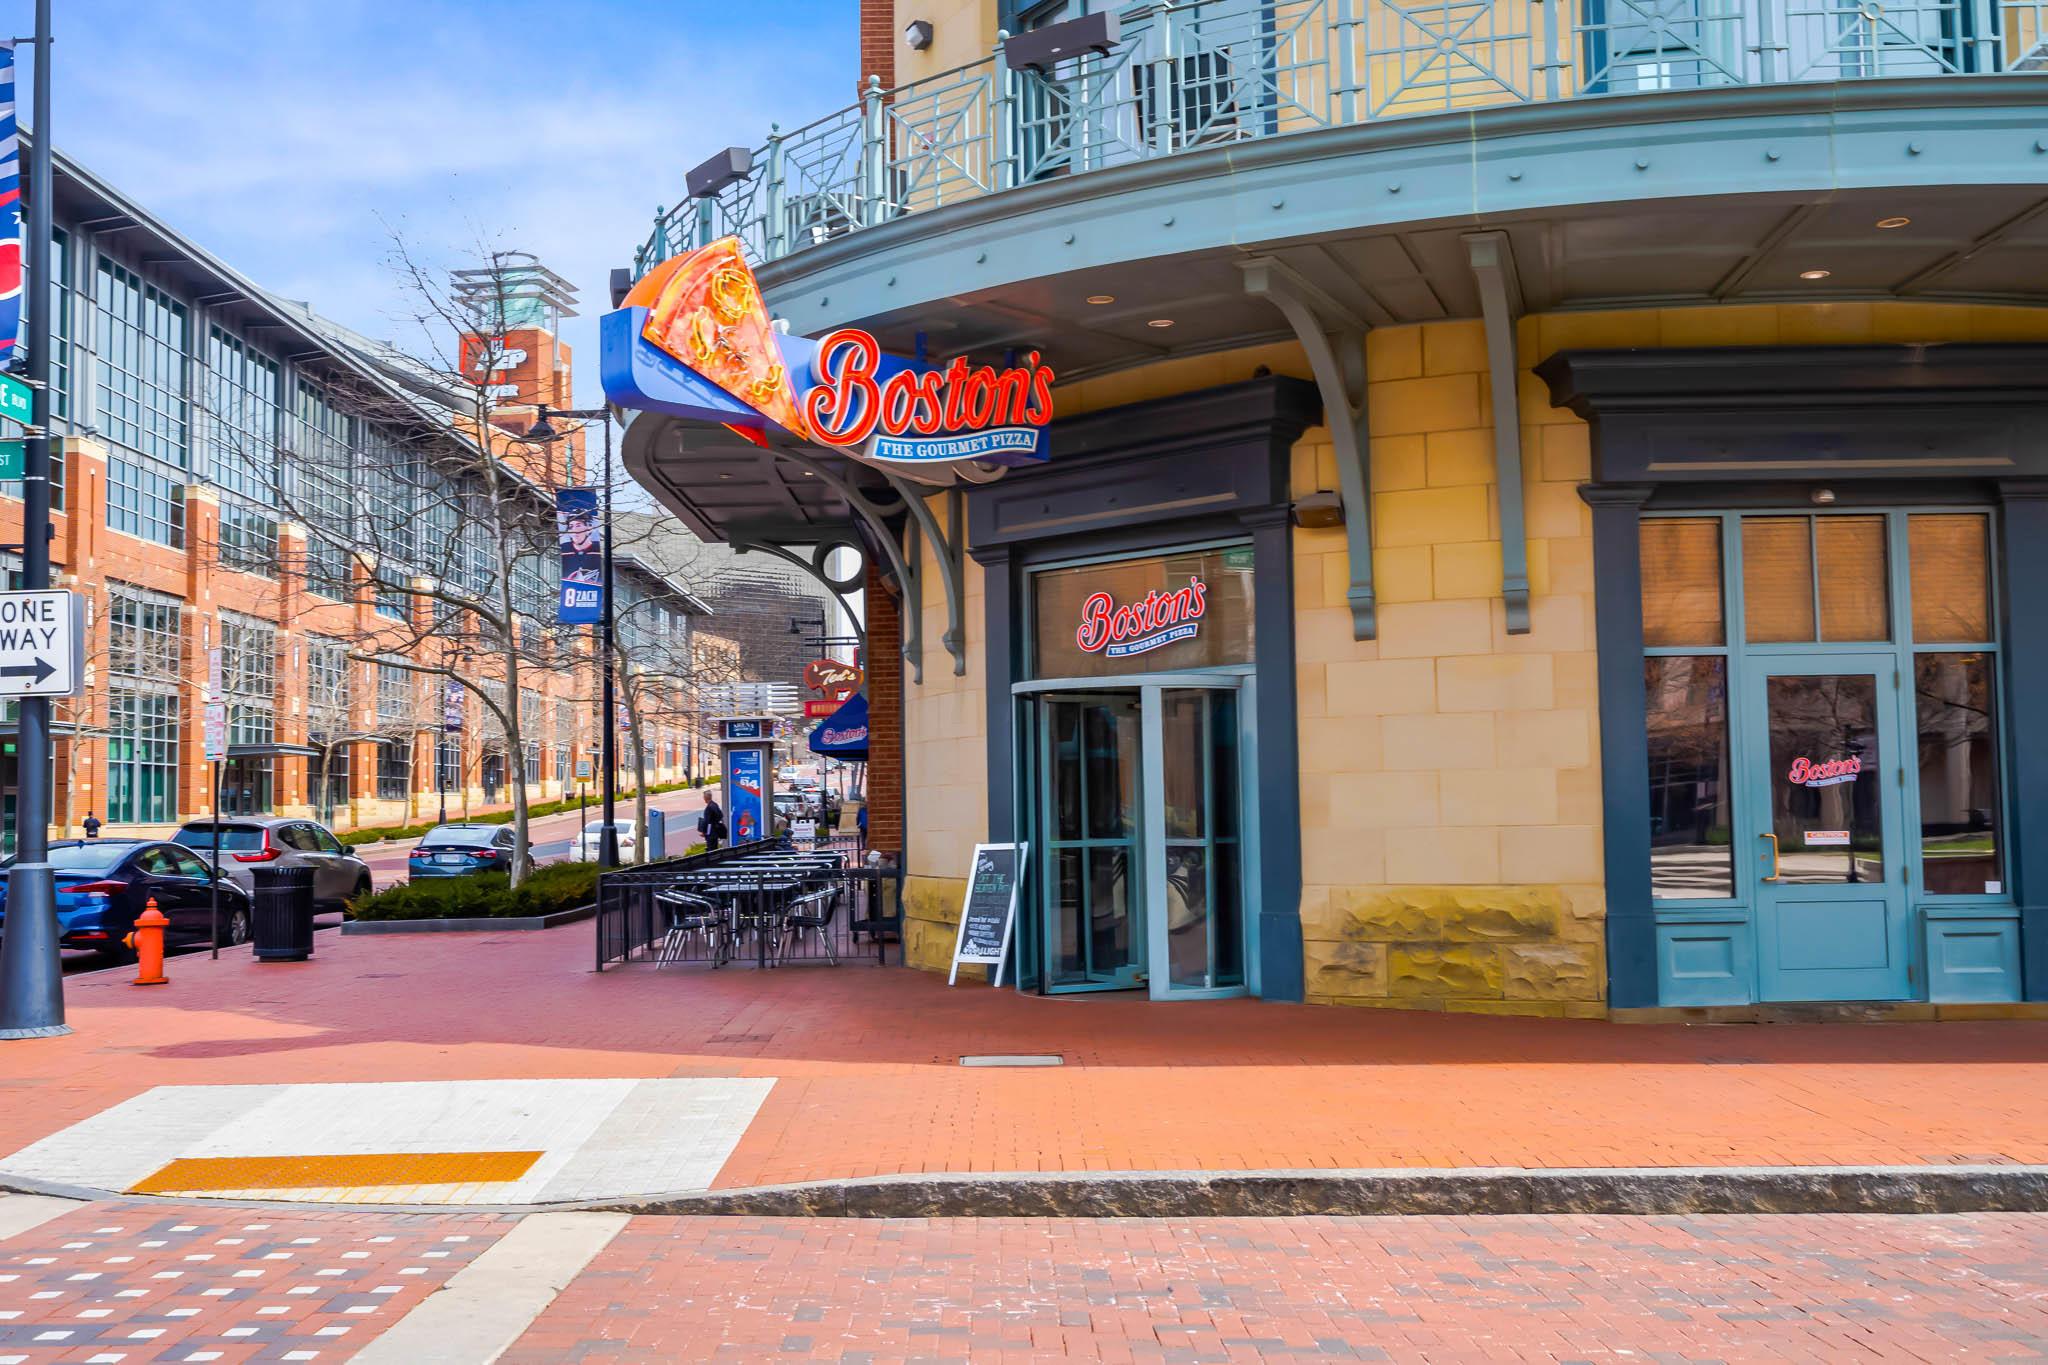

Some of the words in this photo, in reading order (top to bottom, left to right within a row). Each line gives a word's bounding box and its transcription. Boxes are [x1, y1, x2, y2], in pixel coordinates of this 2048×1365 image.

[806, 328, 1056, 447] Boston's
[881, 442, 914, 457] THE
[916, 440, 988, 457] GOURMET
[991, 433, 1032, 448] PIZZA
[565, 588, 576, 607] 8
[2, 599, 56, 623] ONE
[1076, 576, 1207, 653] Boston's
[0, 627, 57, 651] WAY
[1110, 646, 1127, 656] THE
[1128, 635, 1168, 653] GOURMET
[1169, 627, 1194, 640] PIZZA
[1789, 755, 1862, 784] Boston's
